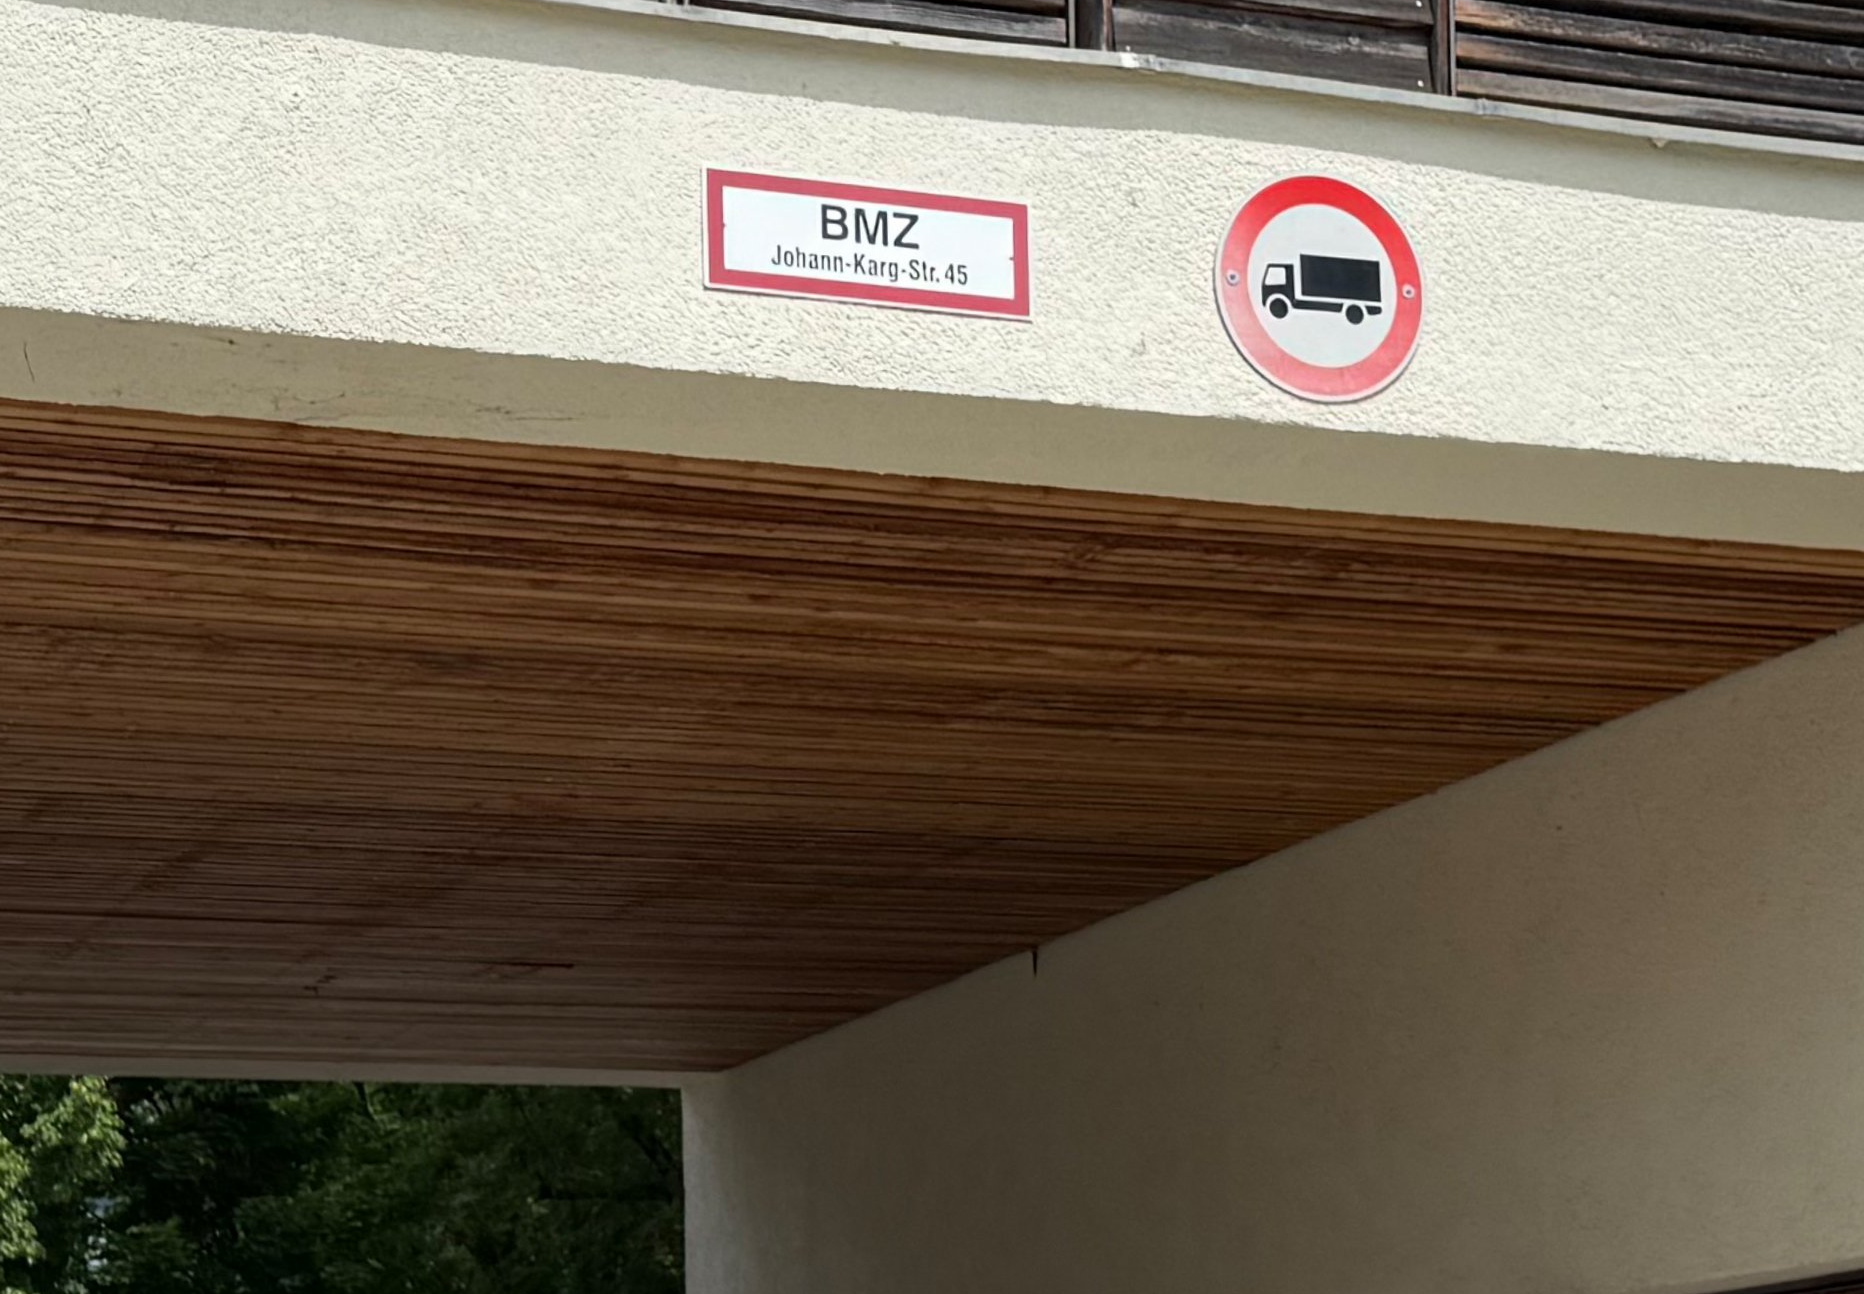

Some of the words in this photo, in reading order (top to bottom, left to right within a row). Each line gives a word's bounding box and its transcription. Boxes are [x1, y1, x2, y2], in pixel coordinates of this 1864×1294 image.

[821, 204, 920, 250] BMZ
[771, 245, 940, 283] Johann-Karg-Str.
[944, 264, 968, 285] 45
